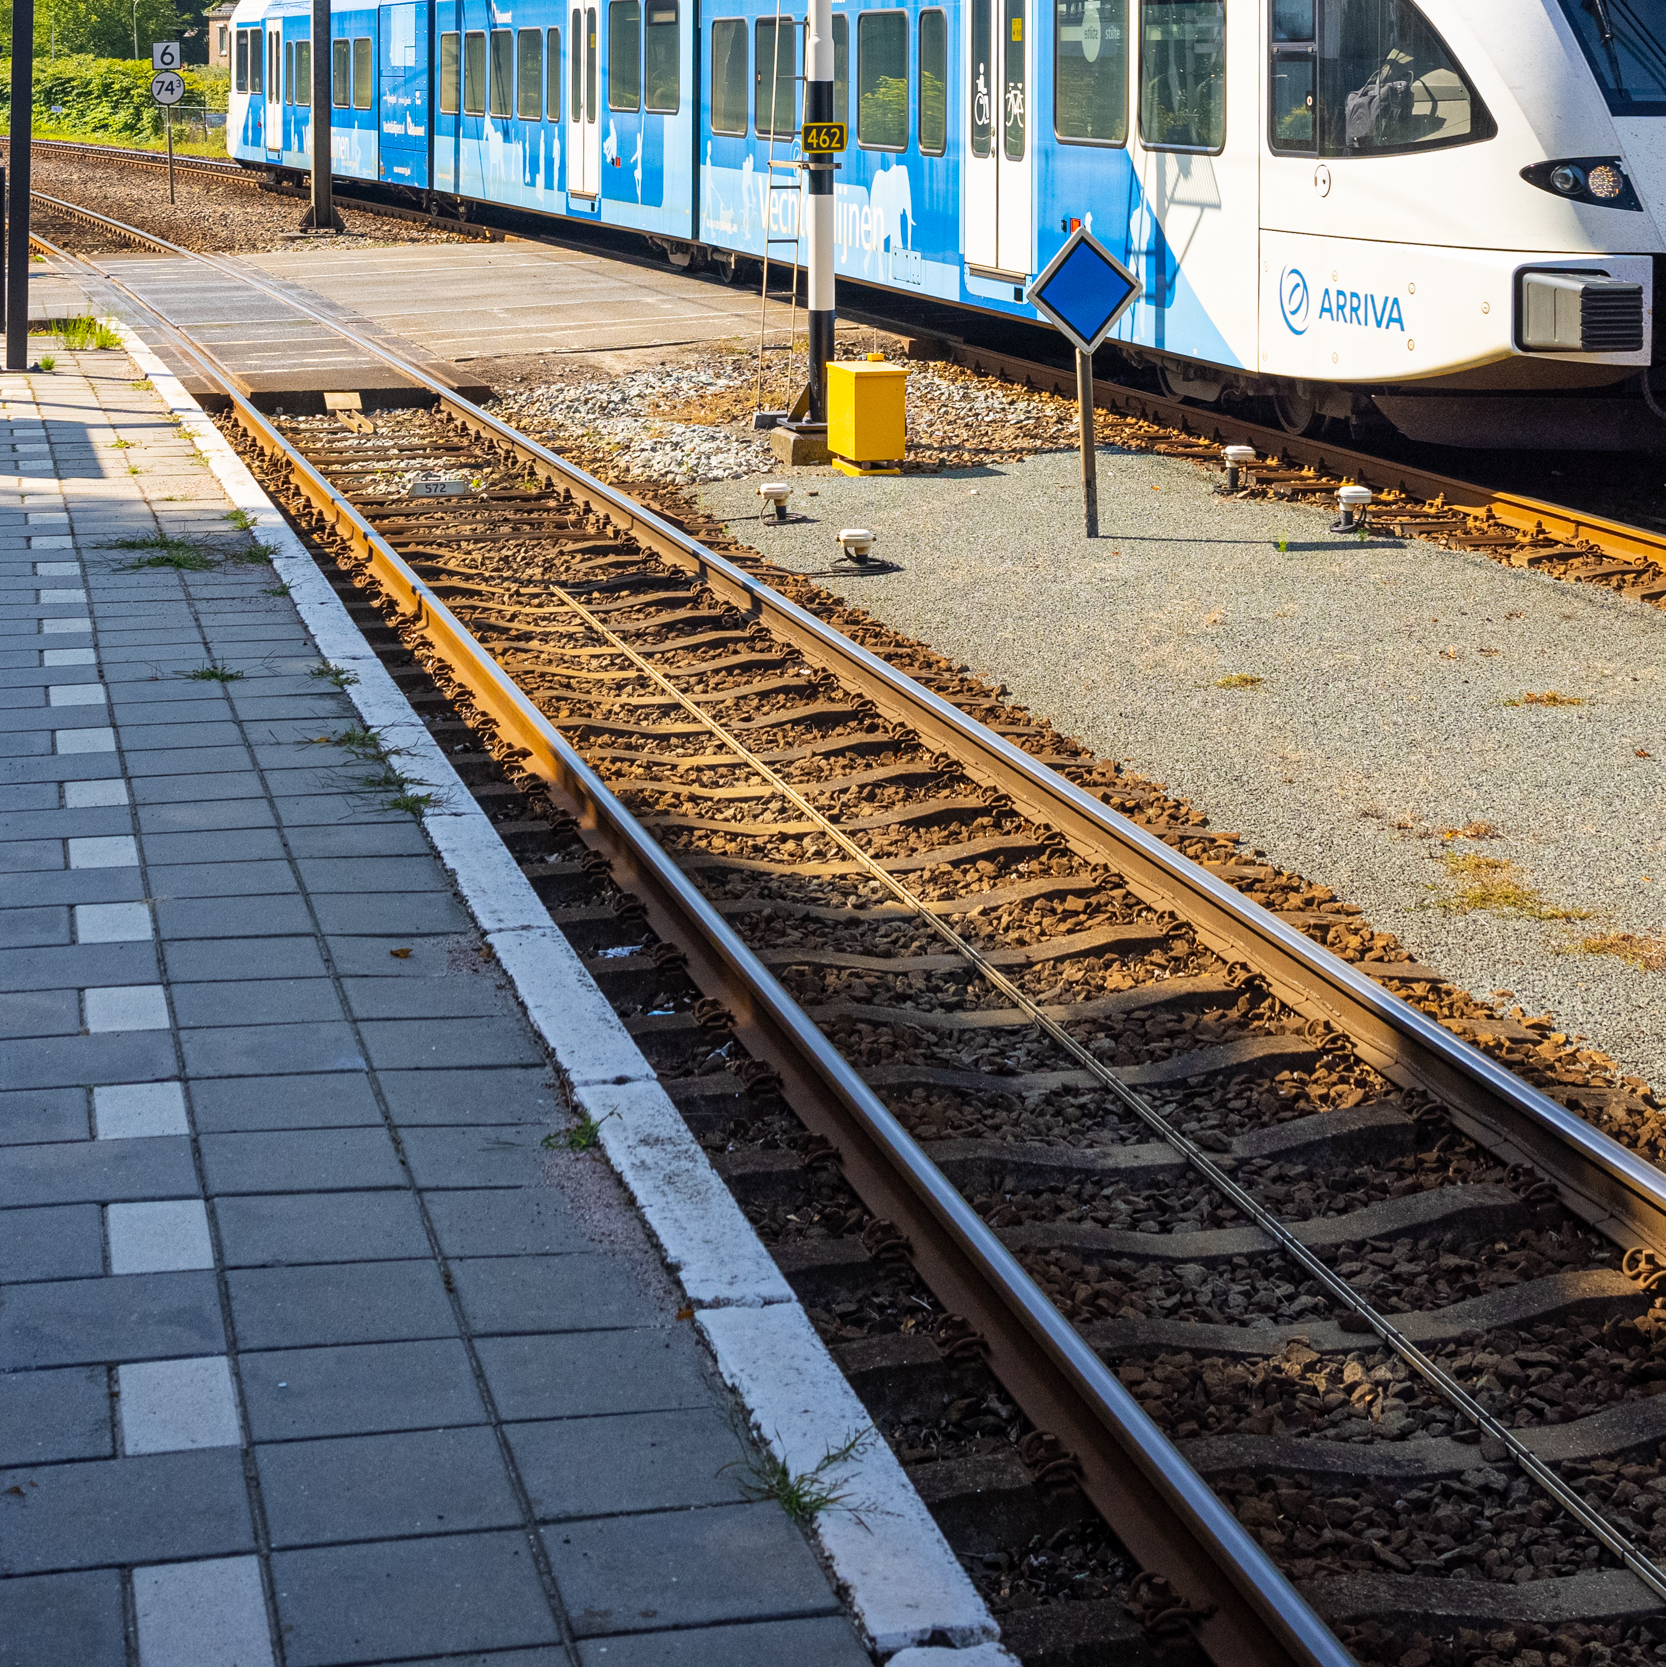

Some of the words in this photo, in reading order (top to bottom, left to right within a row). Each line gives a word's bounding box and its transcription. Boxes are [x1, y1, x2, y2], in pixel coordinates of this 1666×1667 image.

[160, 45, 175, 66] 6
[807, 127, 841, 148] 462
[1318, 287, 1405, 332] ARRIVA
